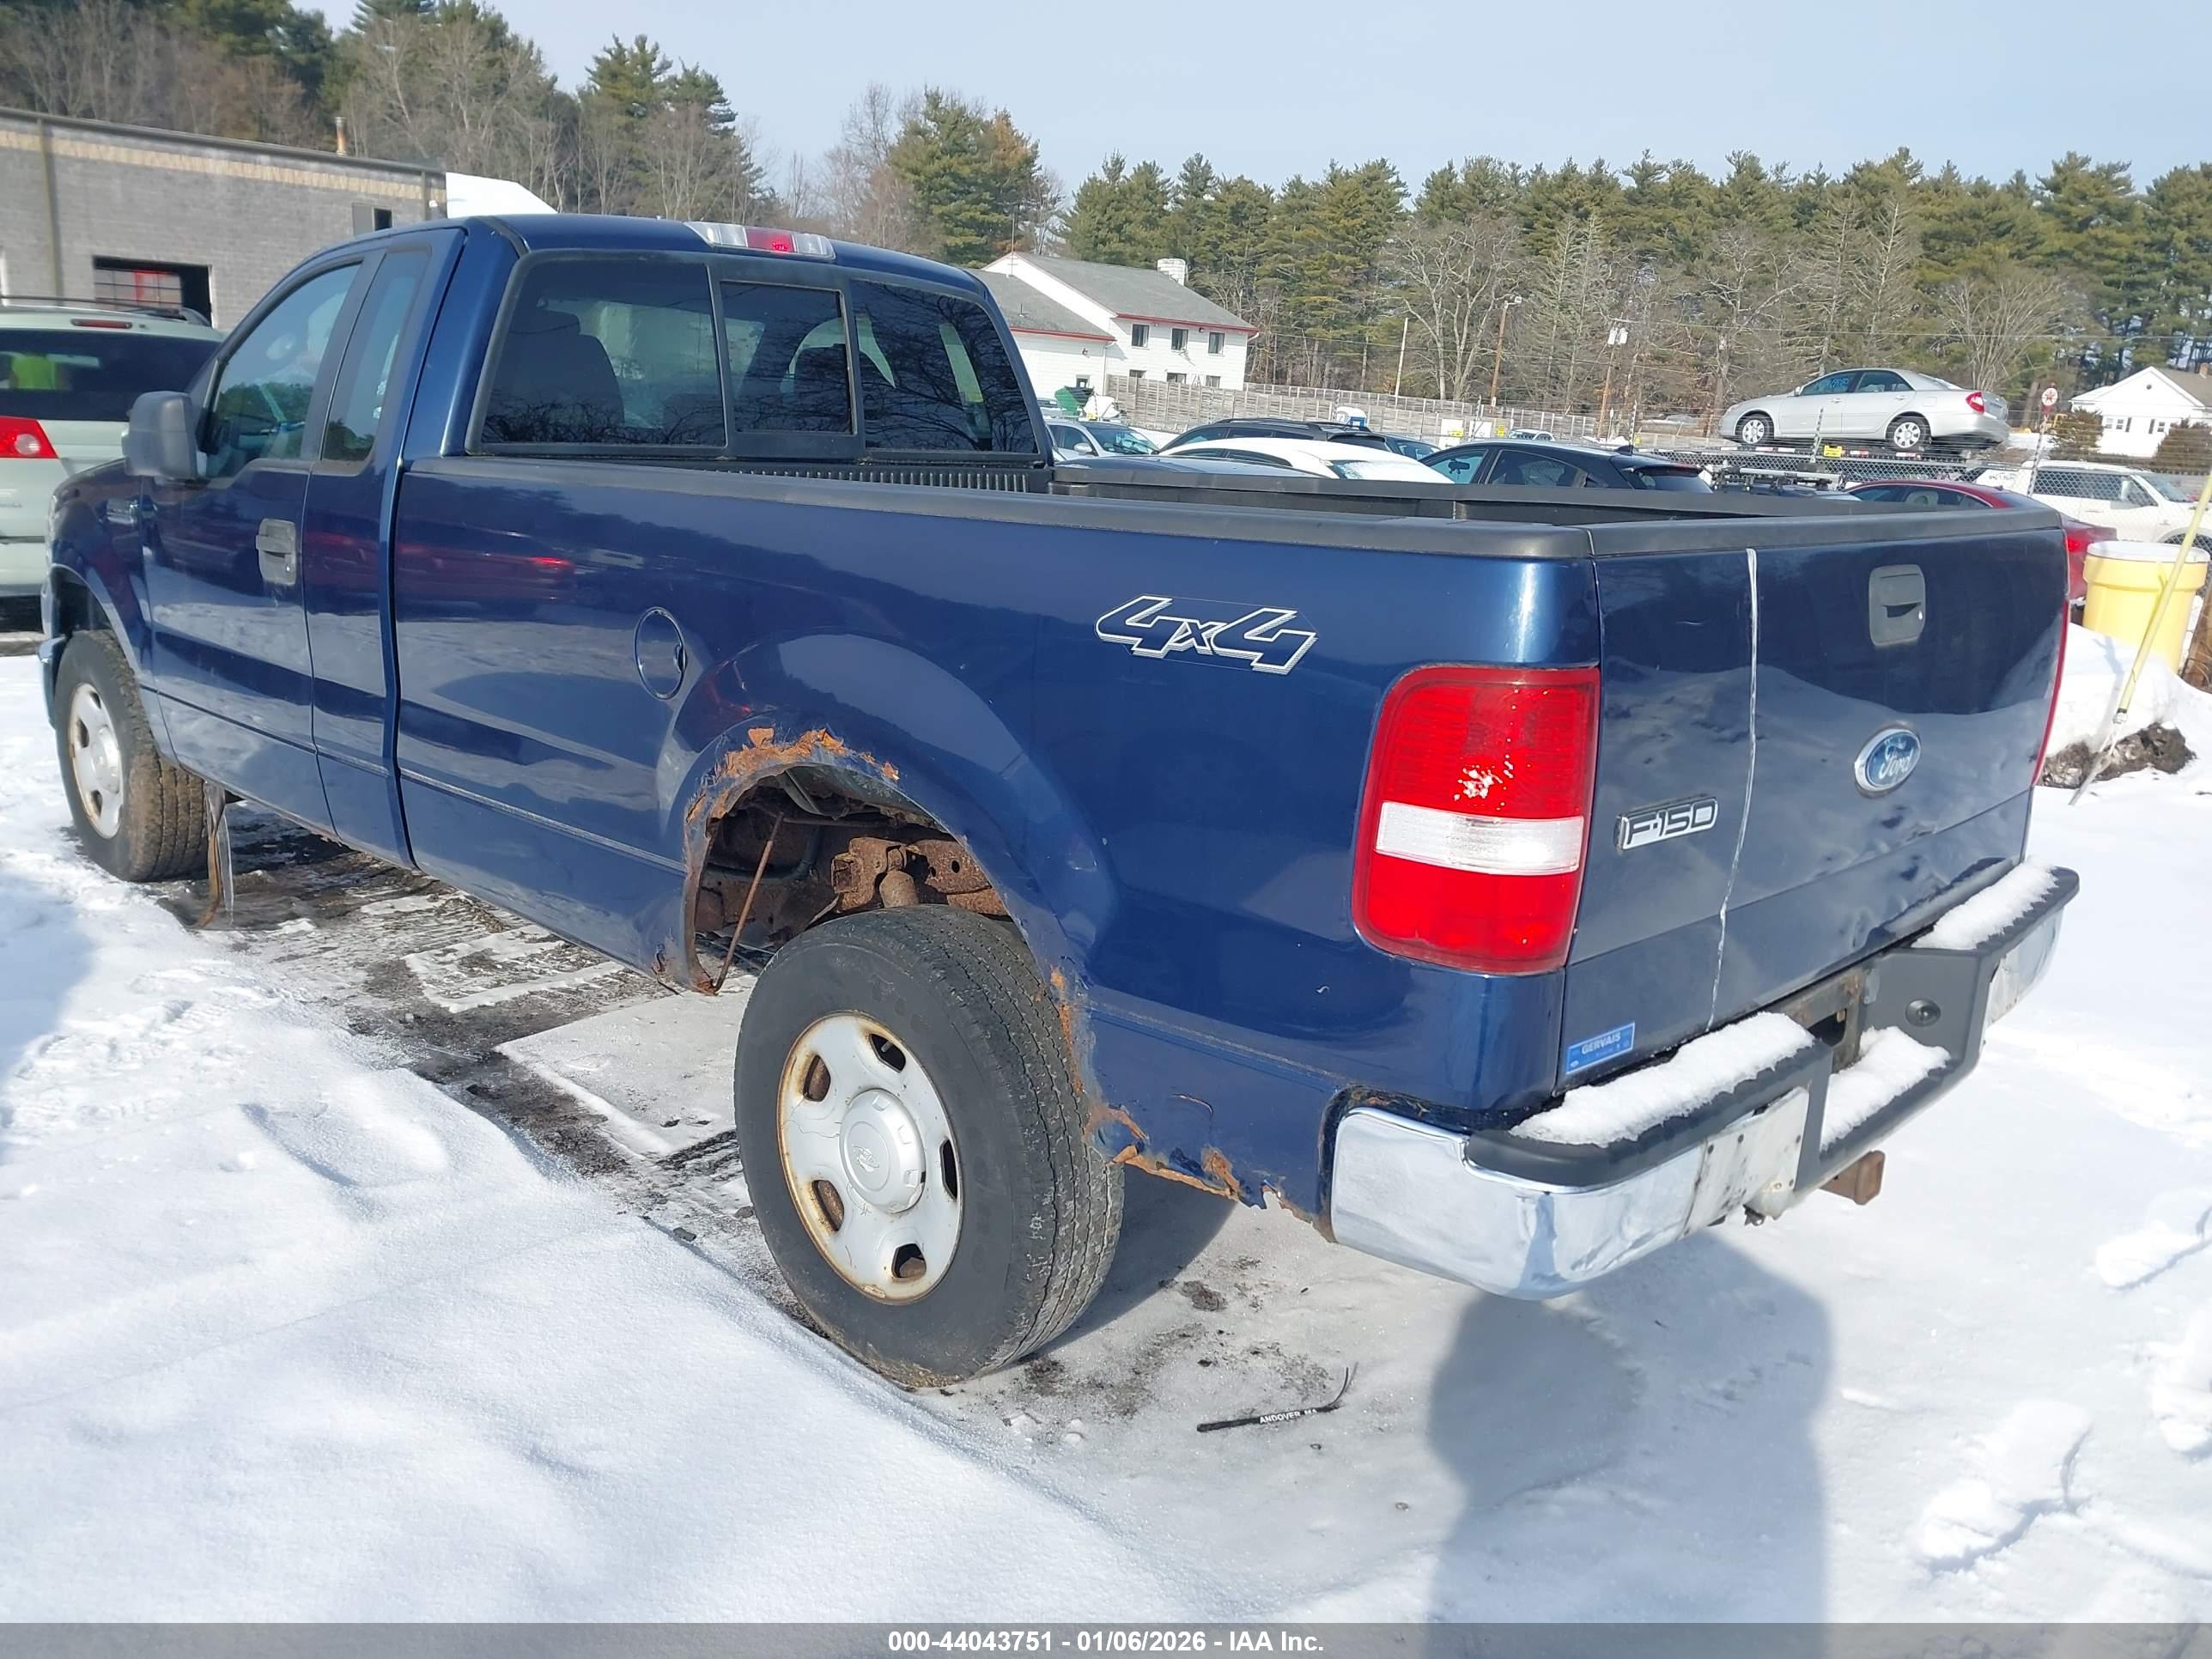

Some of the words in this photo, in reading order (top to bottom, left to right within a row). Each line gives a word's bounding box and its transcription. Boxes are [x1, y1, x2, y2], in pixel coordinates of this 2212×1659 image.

[1878, 737, 1914, 780] Ford
[1581, 1031, 1622, 1055] GERVAIS
[1259, 1411, 1301, 1424] ANDOVER
